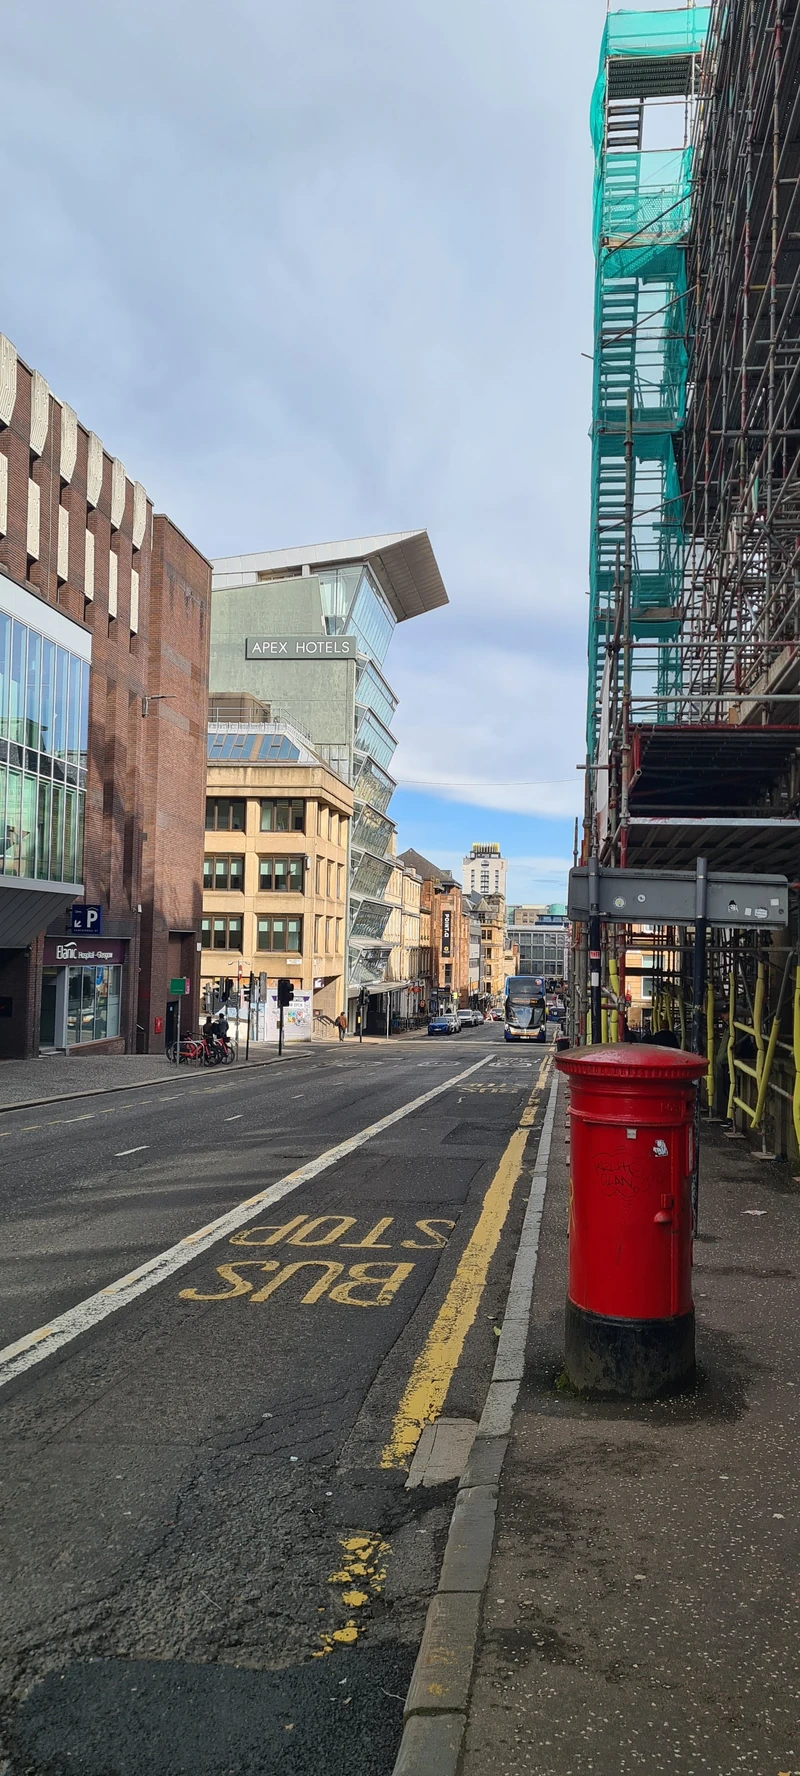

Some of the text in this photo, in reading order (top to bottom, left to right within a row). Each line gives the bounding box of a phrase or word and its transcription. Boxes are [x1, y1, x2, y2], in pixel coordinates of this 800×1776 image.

[252, 641, 350, 654] APEX HOTELS
[86, 910, 99, 928] P
[56, 942, 77, 960] Elanic
[228, 1214, 456, 1249] STOP
[178, 1260, 416, 1308] BUS
